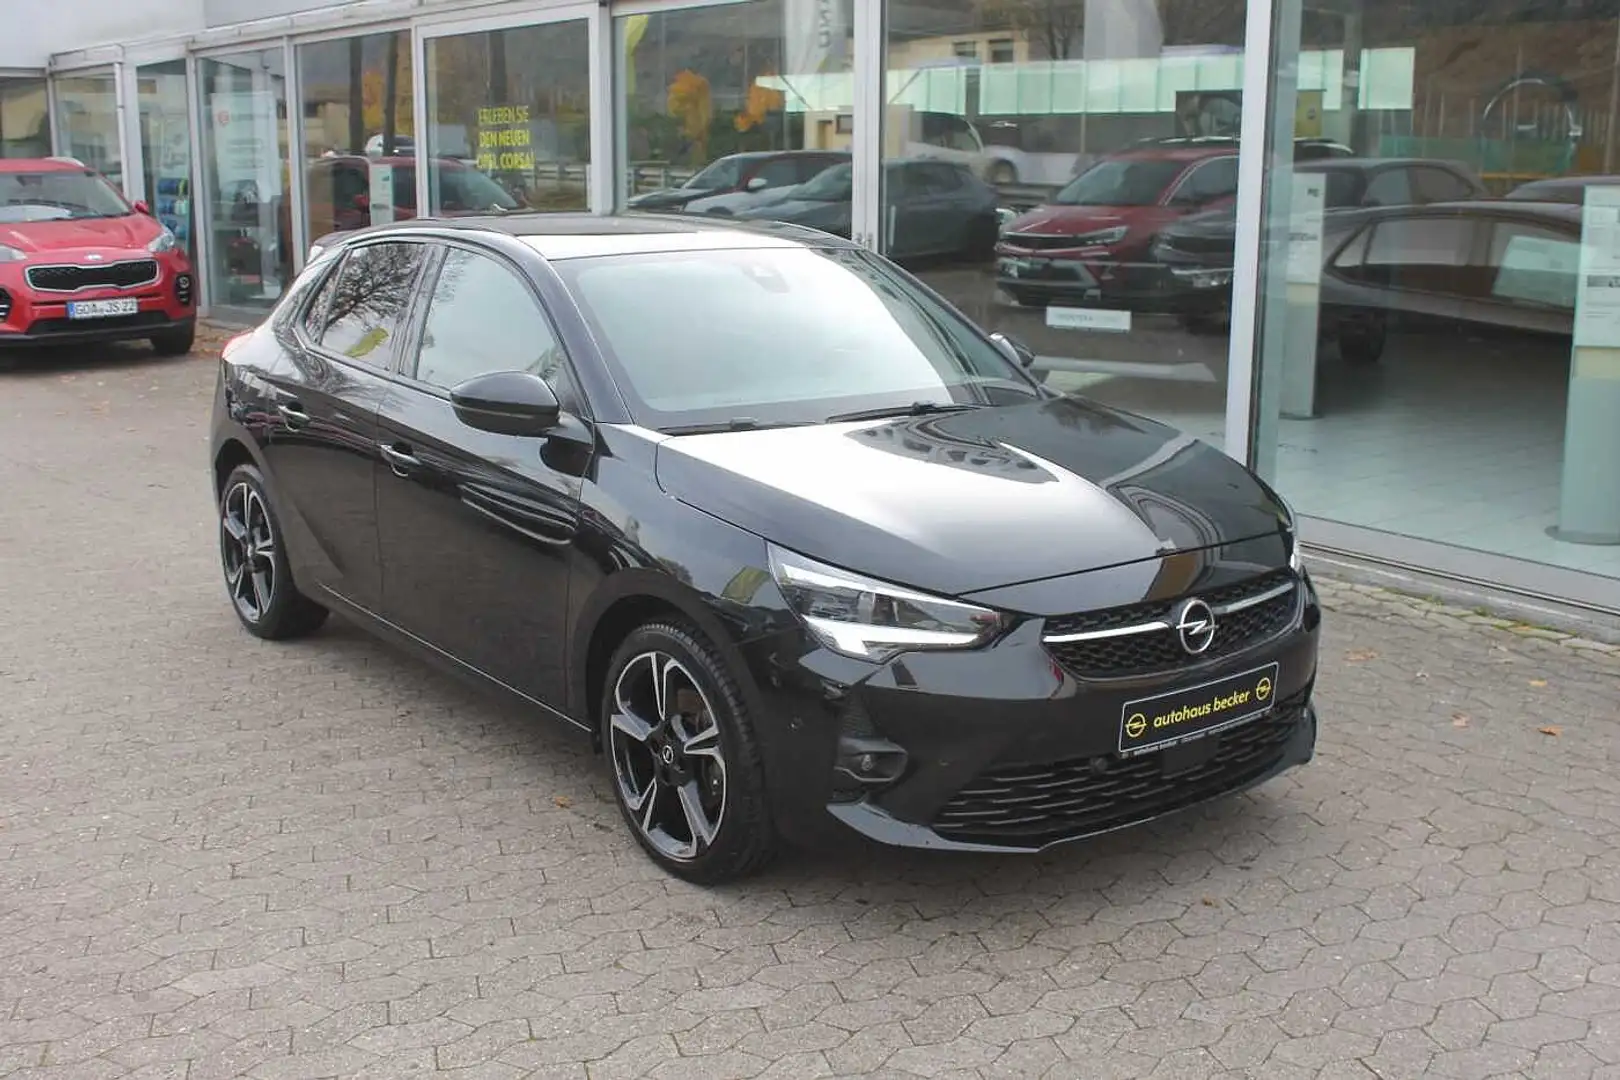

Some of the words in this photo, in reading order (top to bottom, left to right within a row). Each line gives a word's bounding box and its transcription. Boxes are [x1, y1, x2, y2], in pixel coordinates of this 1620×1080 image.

[479, 131, 498, 148] DEN
[499, 129, 530, 146] NEUEN
[1153, 702, 1211, 728] autohaus
[1213, 690, 1251, 712] becker
